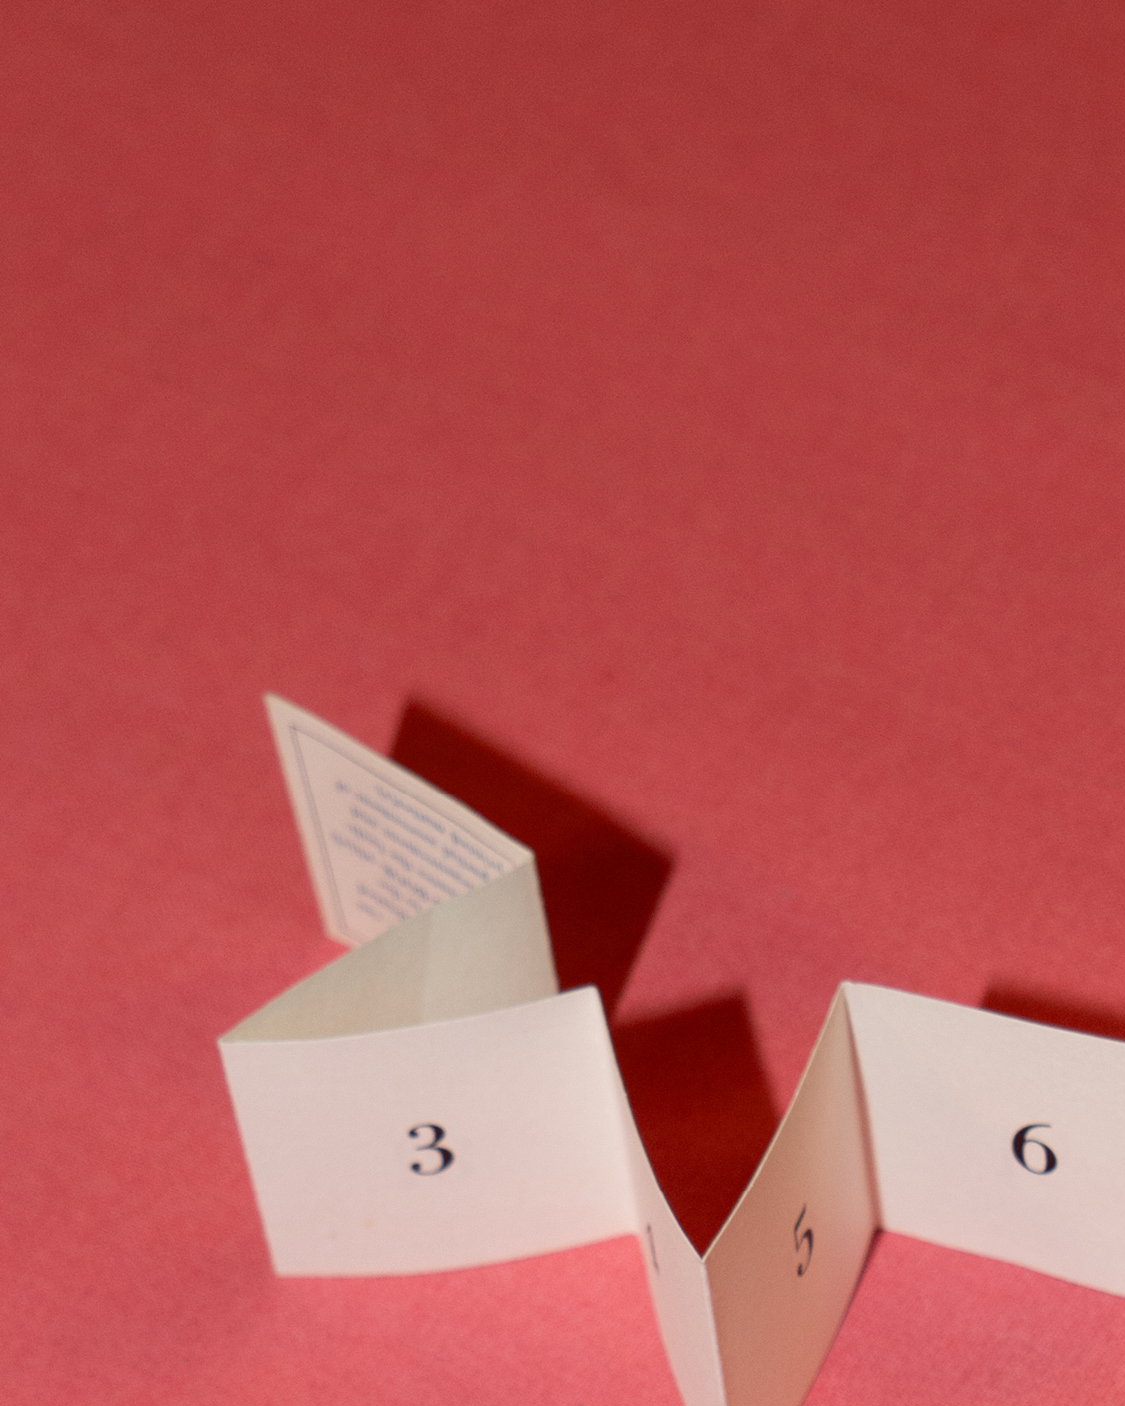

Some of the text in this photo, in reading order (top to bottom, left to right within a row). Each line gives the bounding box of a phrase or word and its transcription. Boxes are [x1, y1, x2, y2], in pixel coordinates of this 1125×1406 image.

[406, 1122, 456, 1176] 3
[1011, 1122, 1060, 1176] 6
[793, 1203, 814, 1277] 5
